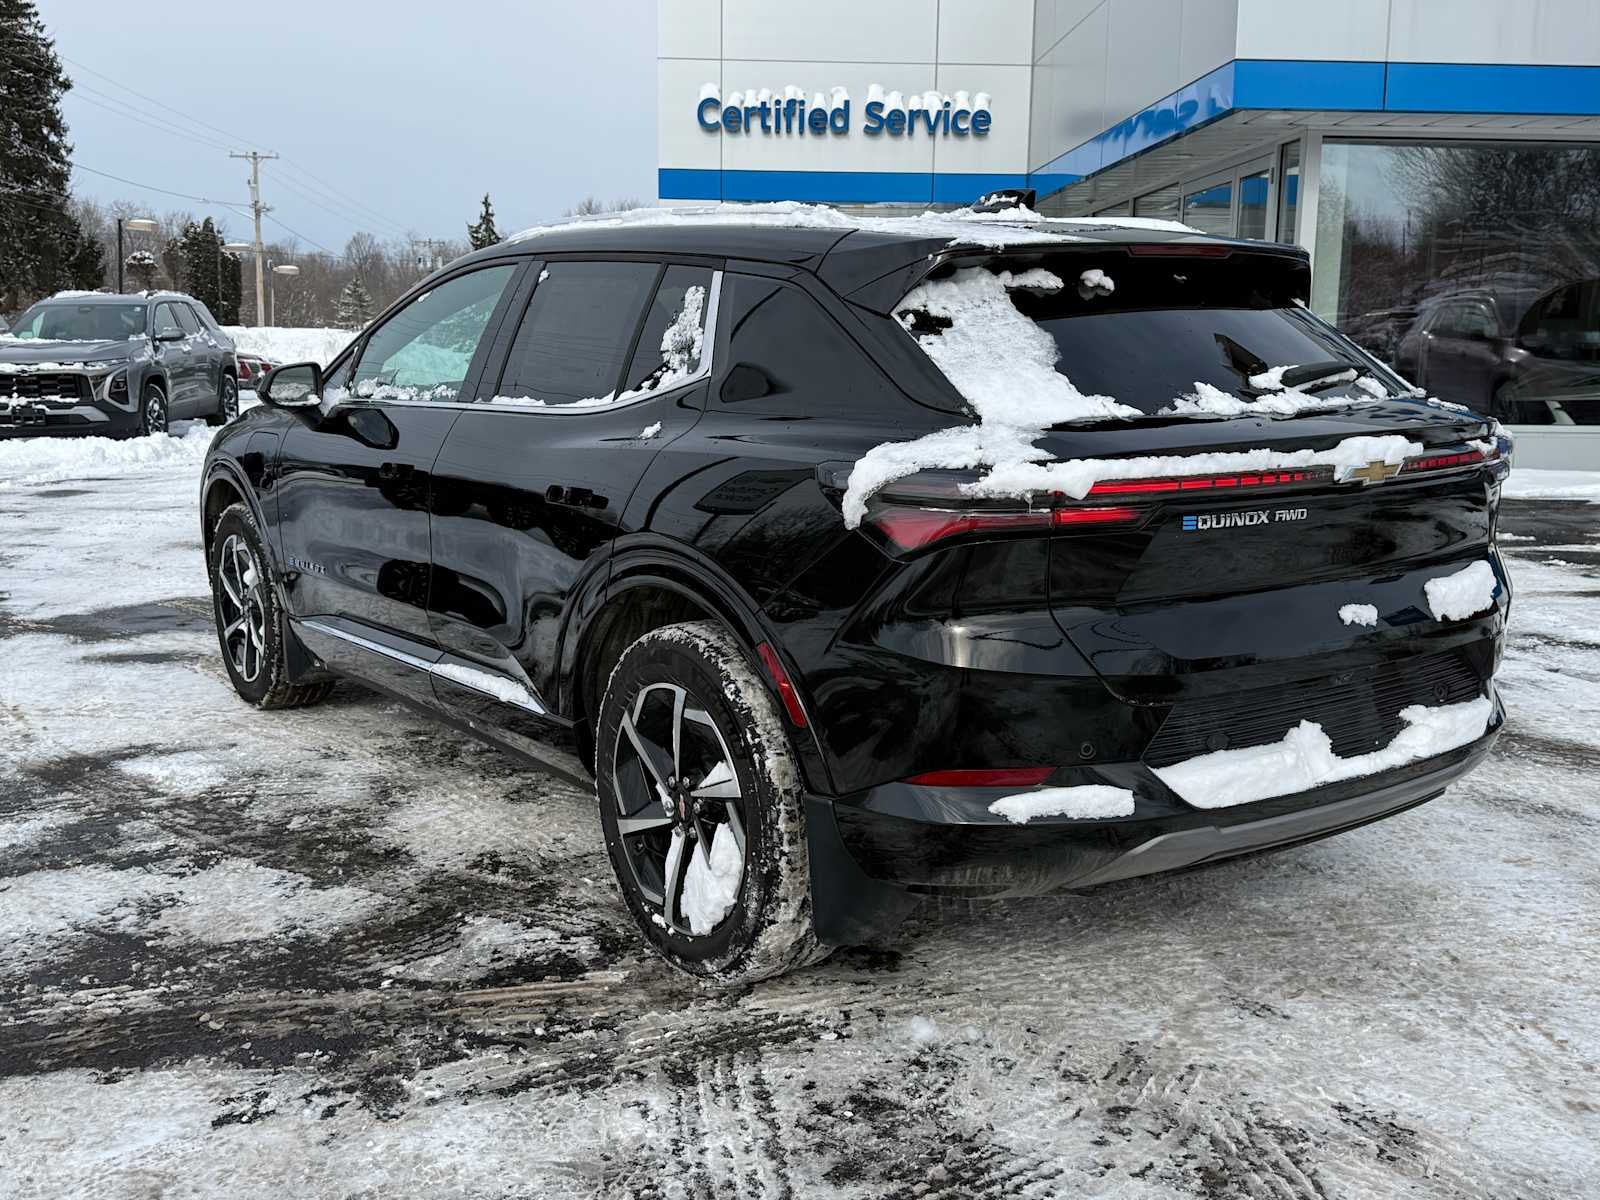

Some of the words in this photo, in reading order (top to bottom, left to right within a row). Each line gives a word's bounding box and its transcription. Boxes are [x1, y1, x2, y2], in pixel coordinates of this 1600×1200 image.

[697, 97, 850, 134] Certified
[863, 100, 992, 135] Service
[1182, 510, 1271, 531] EQUINOX
[1275, 508, 1308, 522] AWD
